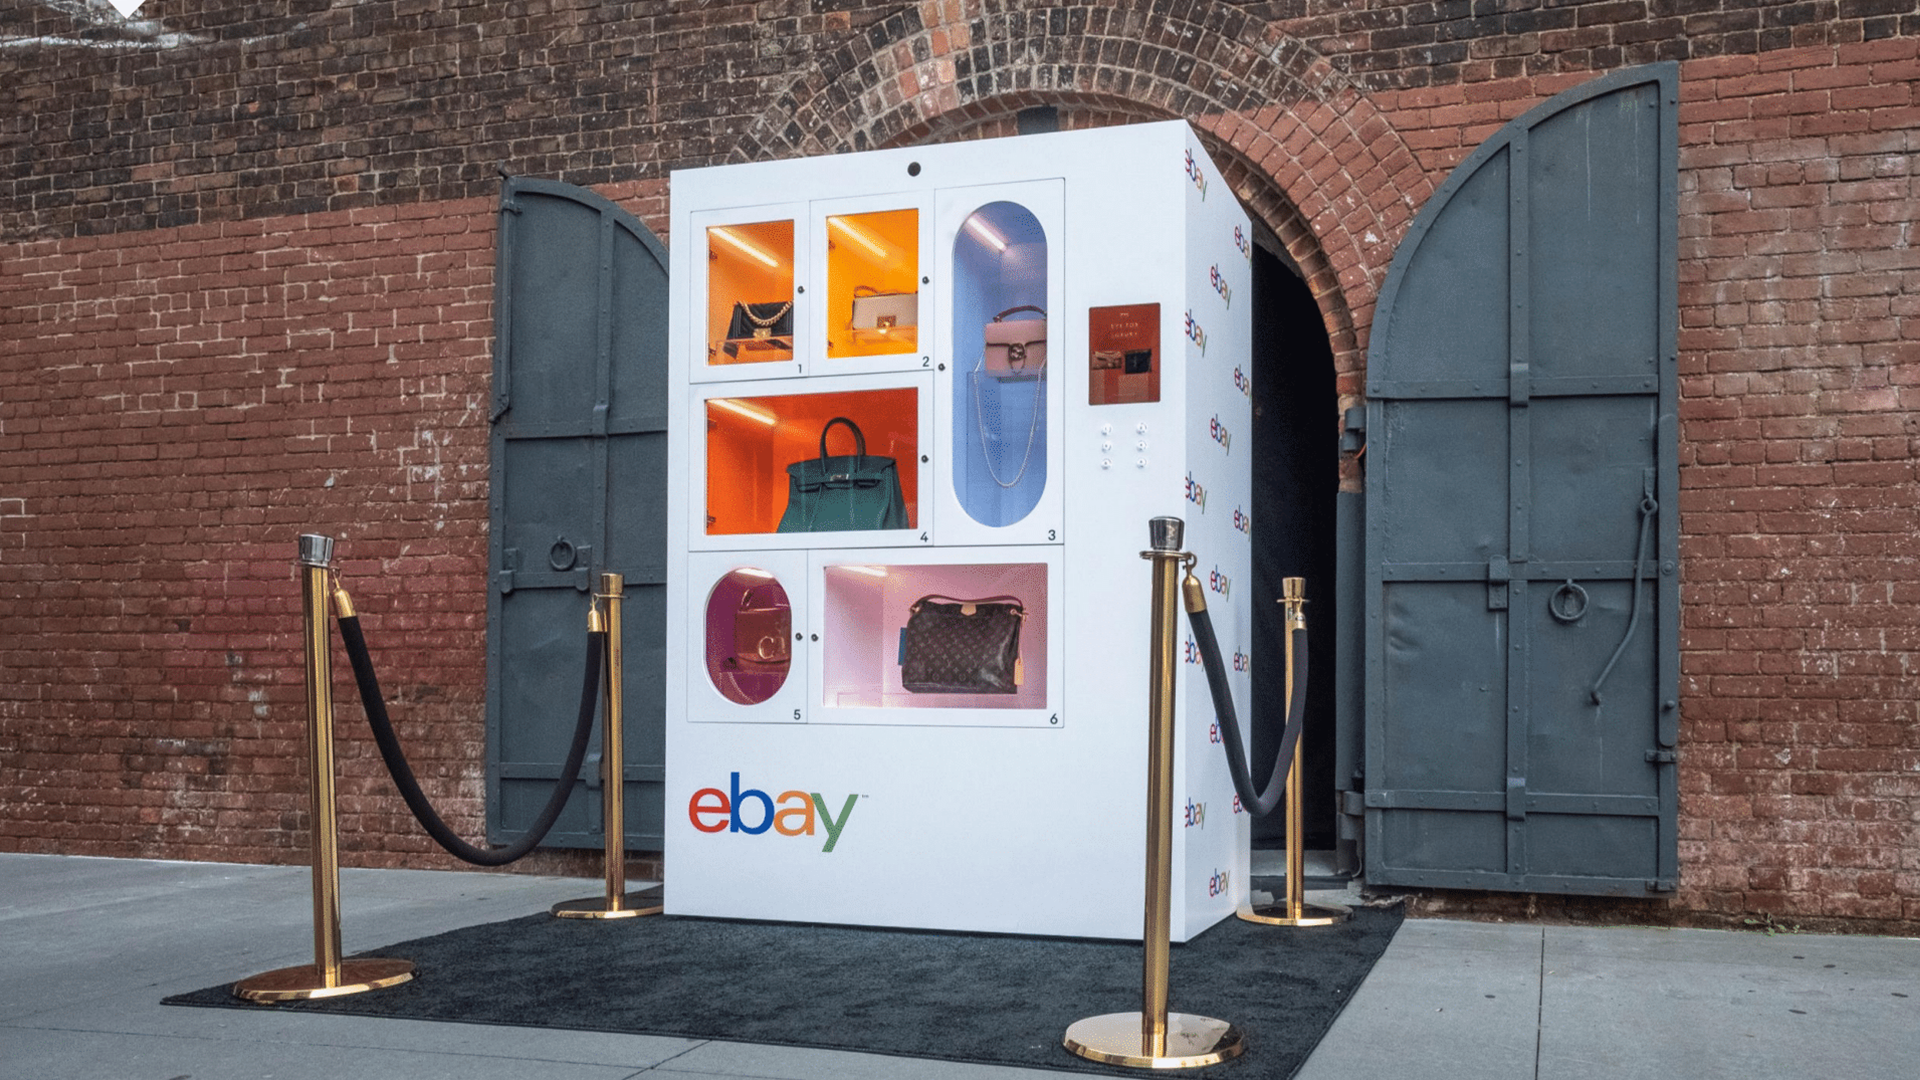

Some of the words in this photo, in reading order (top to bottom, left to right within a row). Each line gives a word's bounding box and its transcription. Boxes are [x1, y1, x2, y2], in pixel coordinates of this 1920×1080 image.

[1211, 263, 1231, 310] ebay
[798, 364, 802, 374] 1
[922, 356, 930, 367] 2
[1210, 414, 1231, 456] ebay
[1185, 471, 1207, 515] ebay
[920, 531, 928, 543] 4
[1048, 529, 1056, 541] 3
[1210, 564, 1231, 603] ebay
[1185, 634, 1205, 672] eba
[793, 709, 801, 720] 5
[1050, 713, 1058, 725] 6
[688, 772, 859, 853] ebay
[1185, 797, 1207, 830] ebay
[1209, 868, 1230, 897] ebay
